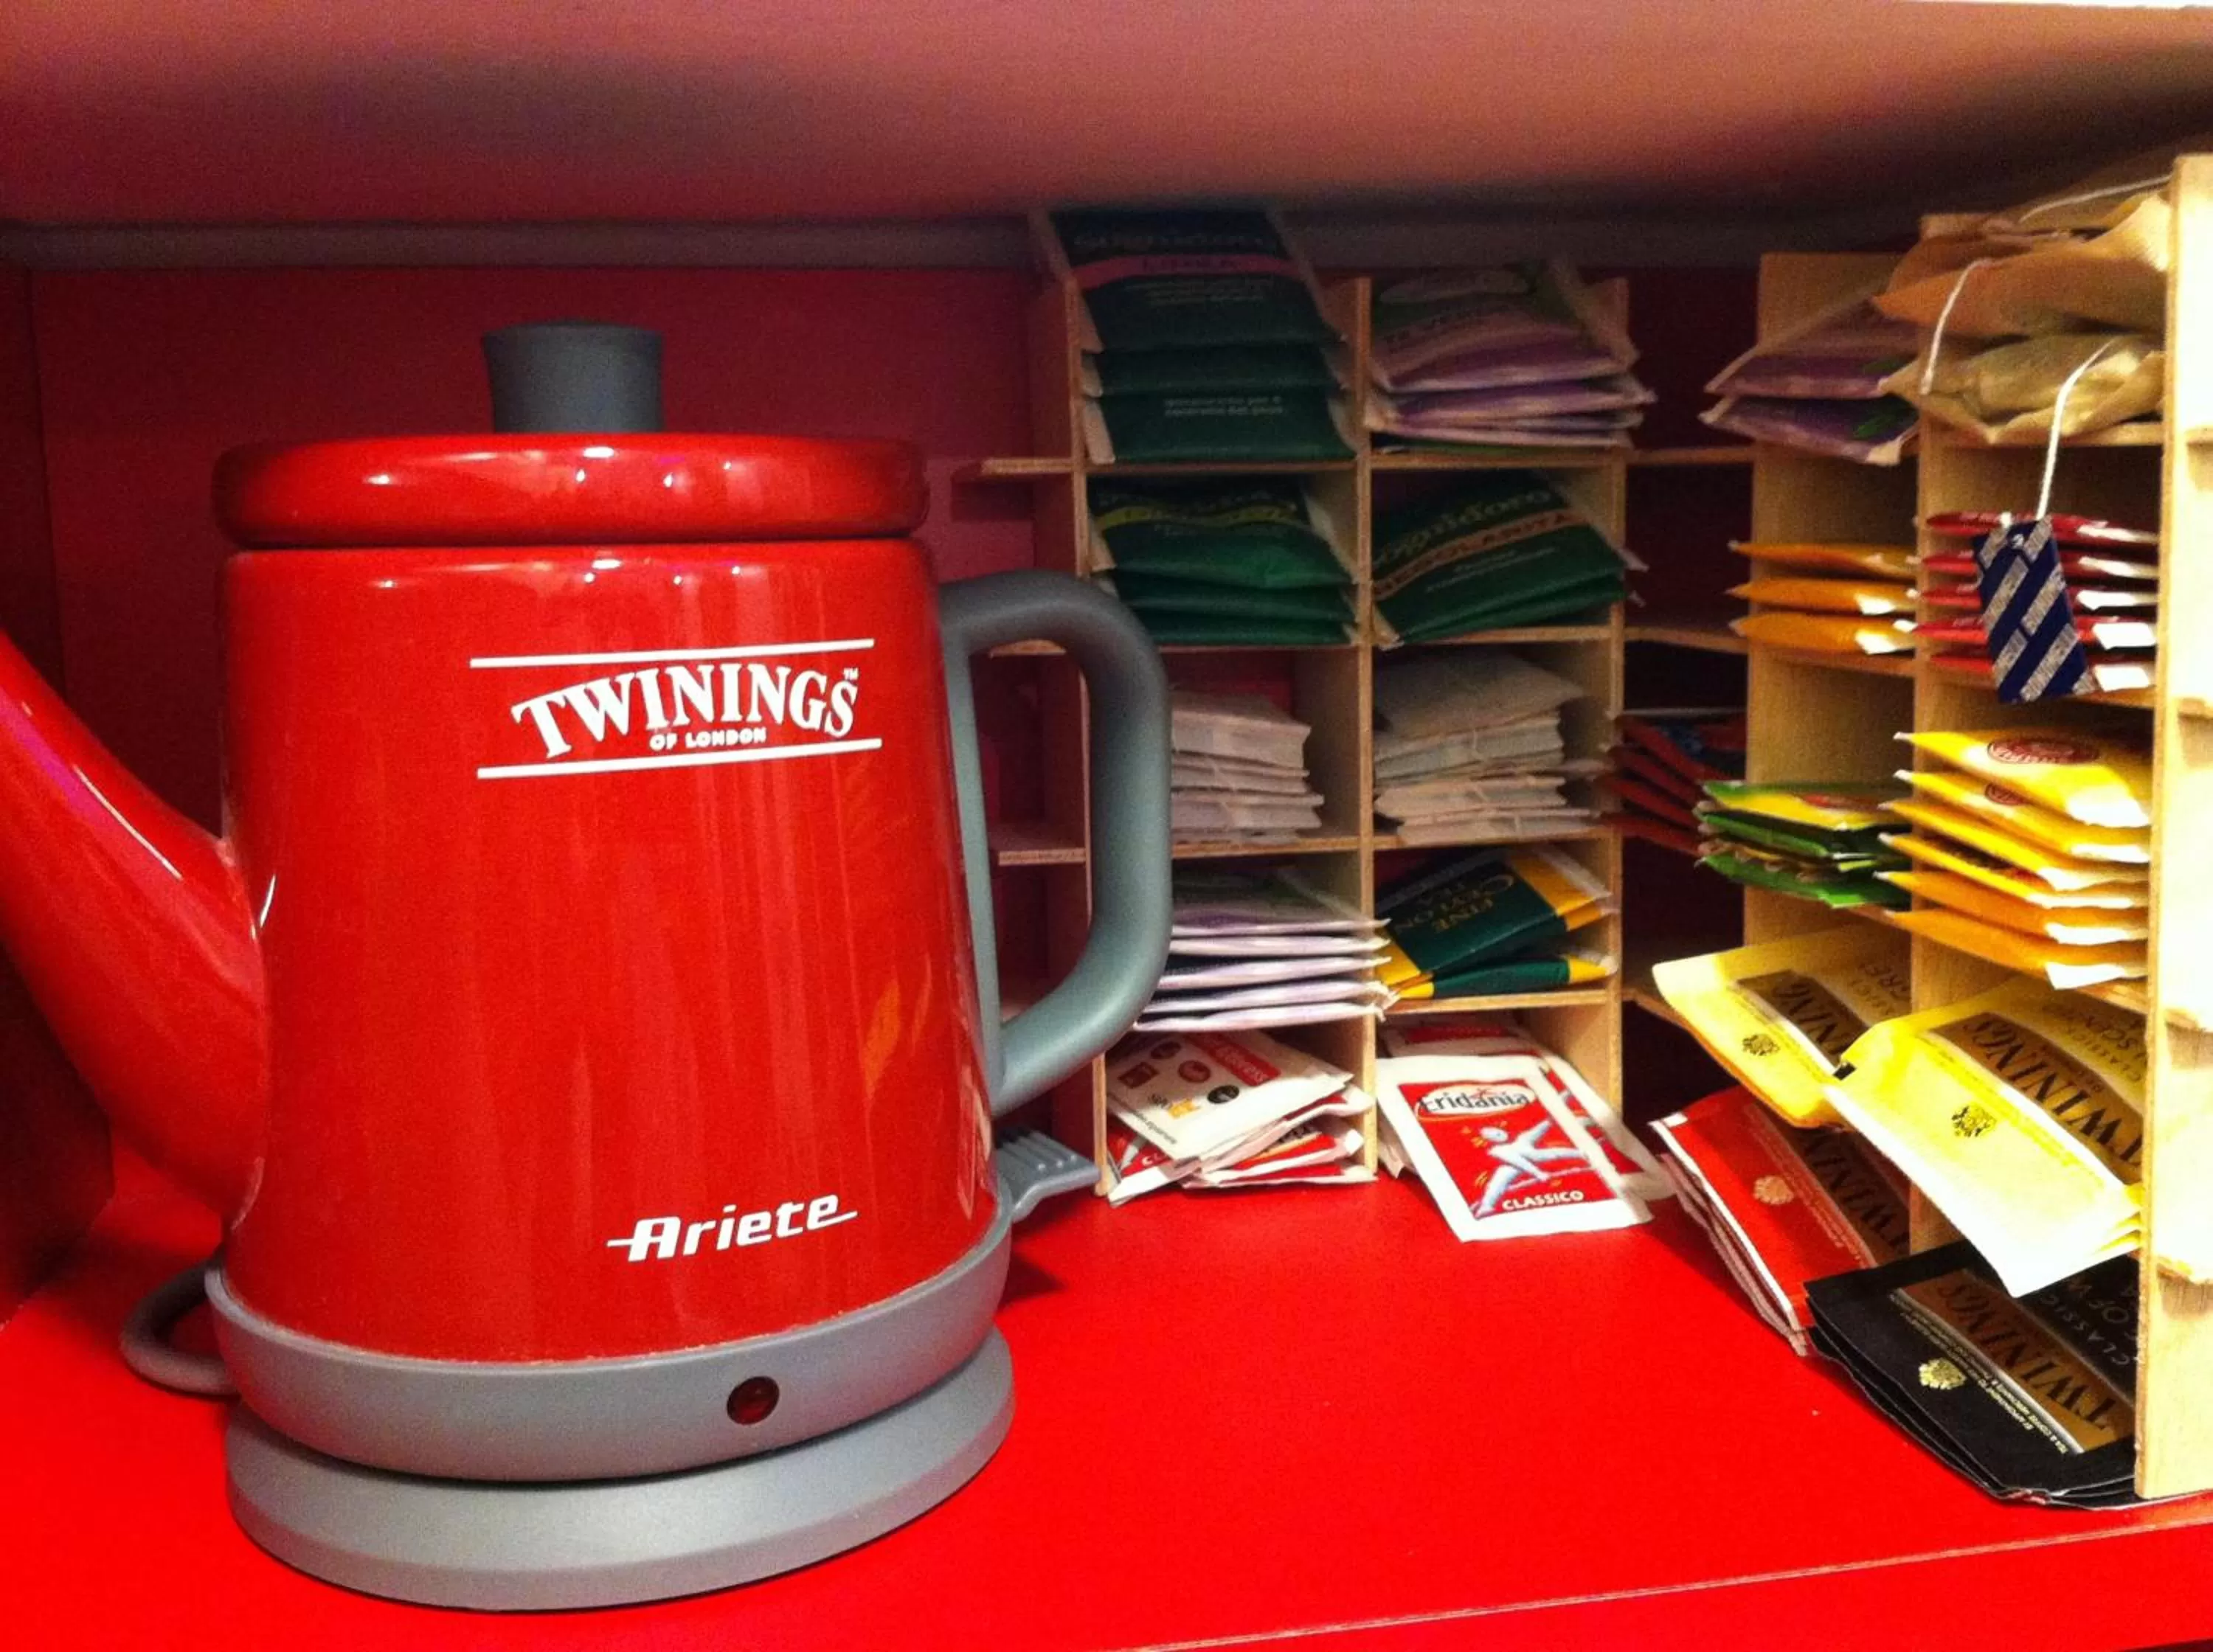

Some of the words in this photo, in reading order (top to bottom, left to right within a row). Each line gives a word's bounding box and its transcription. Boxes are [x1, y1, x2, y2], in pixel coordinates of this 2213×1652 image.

[510, 663, 859, 759] TWININGS
[650, 734, 677, 751] OF
[685, 727, 766, 749] LONDON
[607, 1194, 858, 1263] Ariete
[1502, 1189, 1585, 1211] CLASSICO
[2040, 1295, 2132, 1369] CLASSIC
